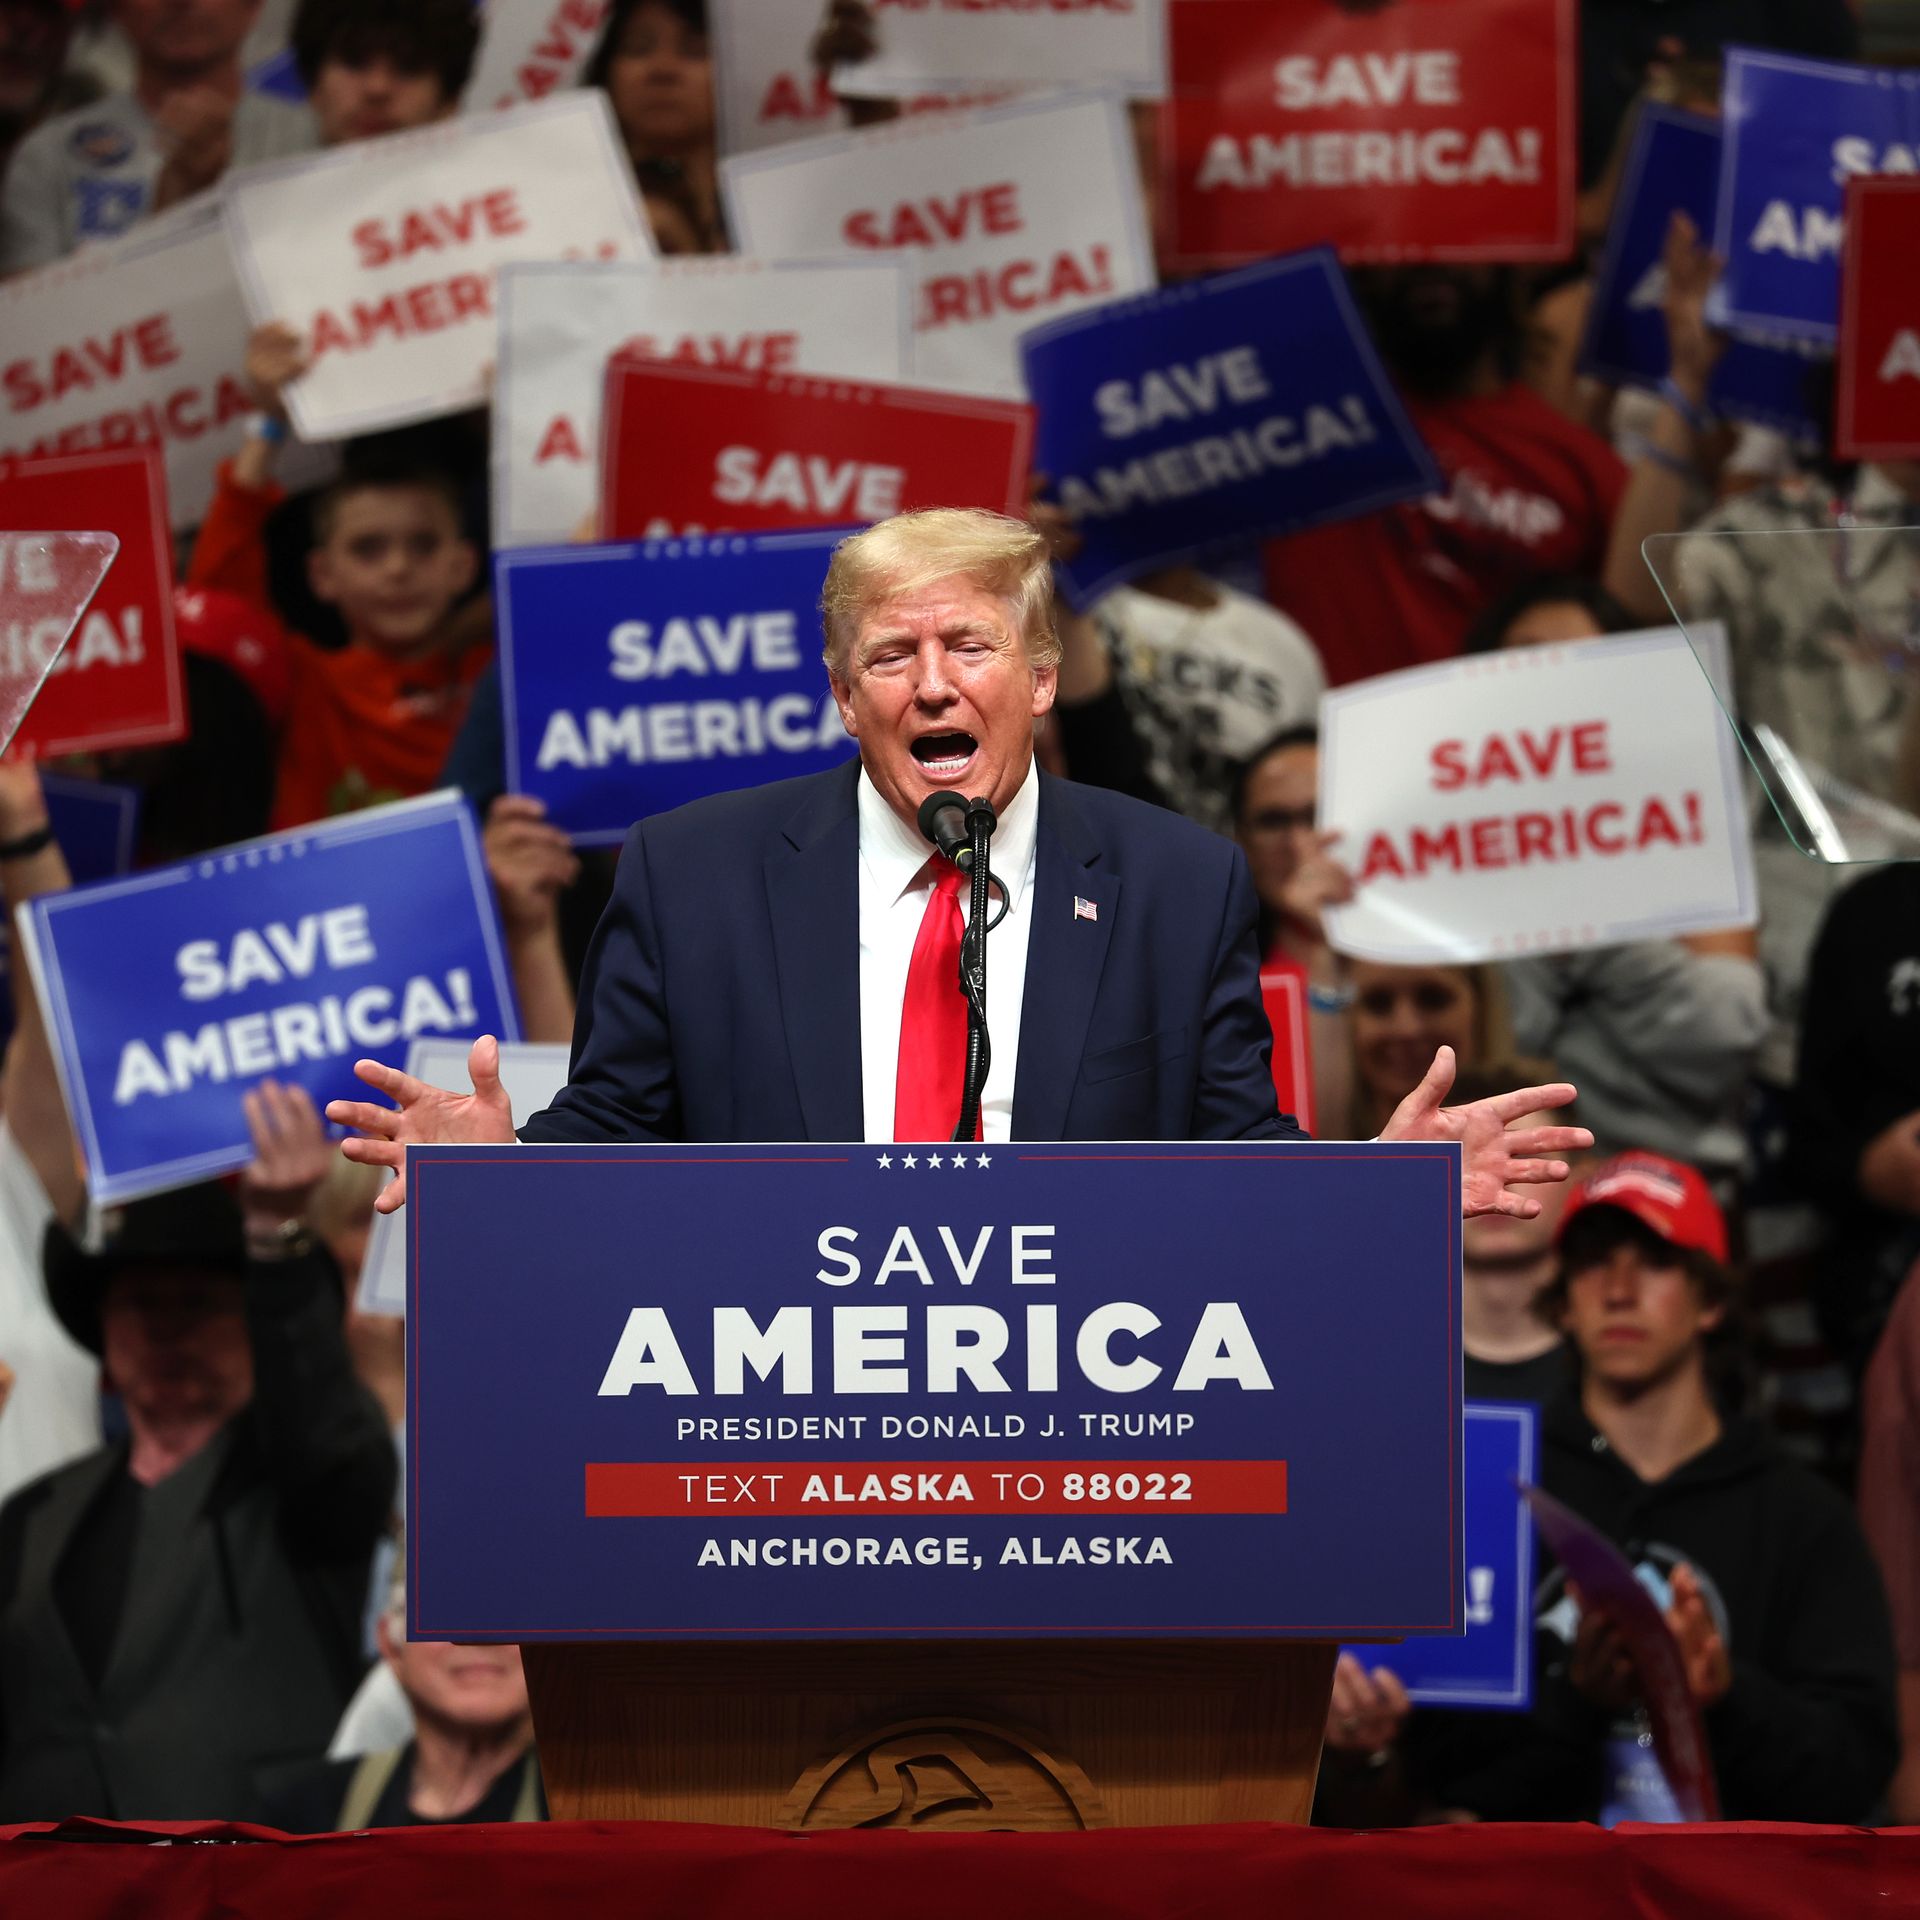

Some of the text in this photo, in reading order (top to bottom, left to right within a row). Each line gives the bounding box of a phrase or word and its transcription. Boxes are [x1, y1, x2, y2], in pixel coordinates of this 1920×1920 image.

[1274, 51, 1460, 111] SAVE
[1196, 127, 1542, 192] AMERICA!
[350, 187, 528, 271] SAVE
[842, 183, 1024, 253] SAVE
[2, 312, 182, 414] SAVE
[1094, 346, 1270, 438] SAVE
[712, 444, 906, 521] SAVE
[1058, 396, 1377, 522] AMERICA!
[608, 610, 802, 682] SAVE
[1429, 720, 1613, 797] SAVE
[1360, 791, 1705, 886] AMERICA!
[176, 903, 377, 1001] SAVE
[114, 967, 478, 1106] AMERICA!
[815, 1225, 1057, 1287] SAVE
[596, 1301, 1275, 1397] AMERICA
[677, 1413, 1195, 1441] PRESIDENT DONALD J. TRUMP
[678, 1472, 1192, 1503] TEXT ALASKA TO 88022
[696, 1536, 1174, 1571] ANCHORAGE, ALASKA
